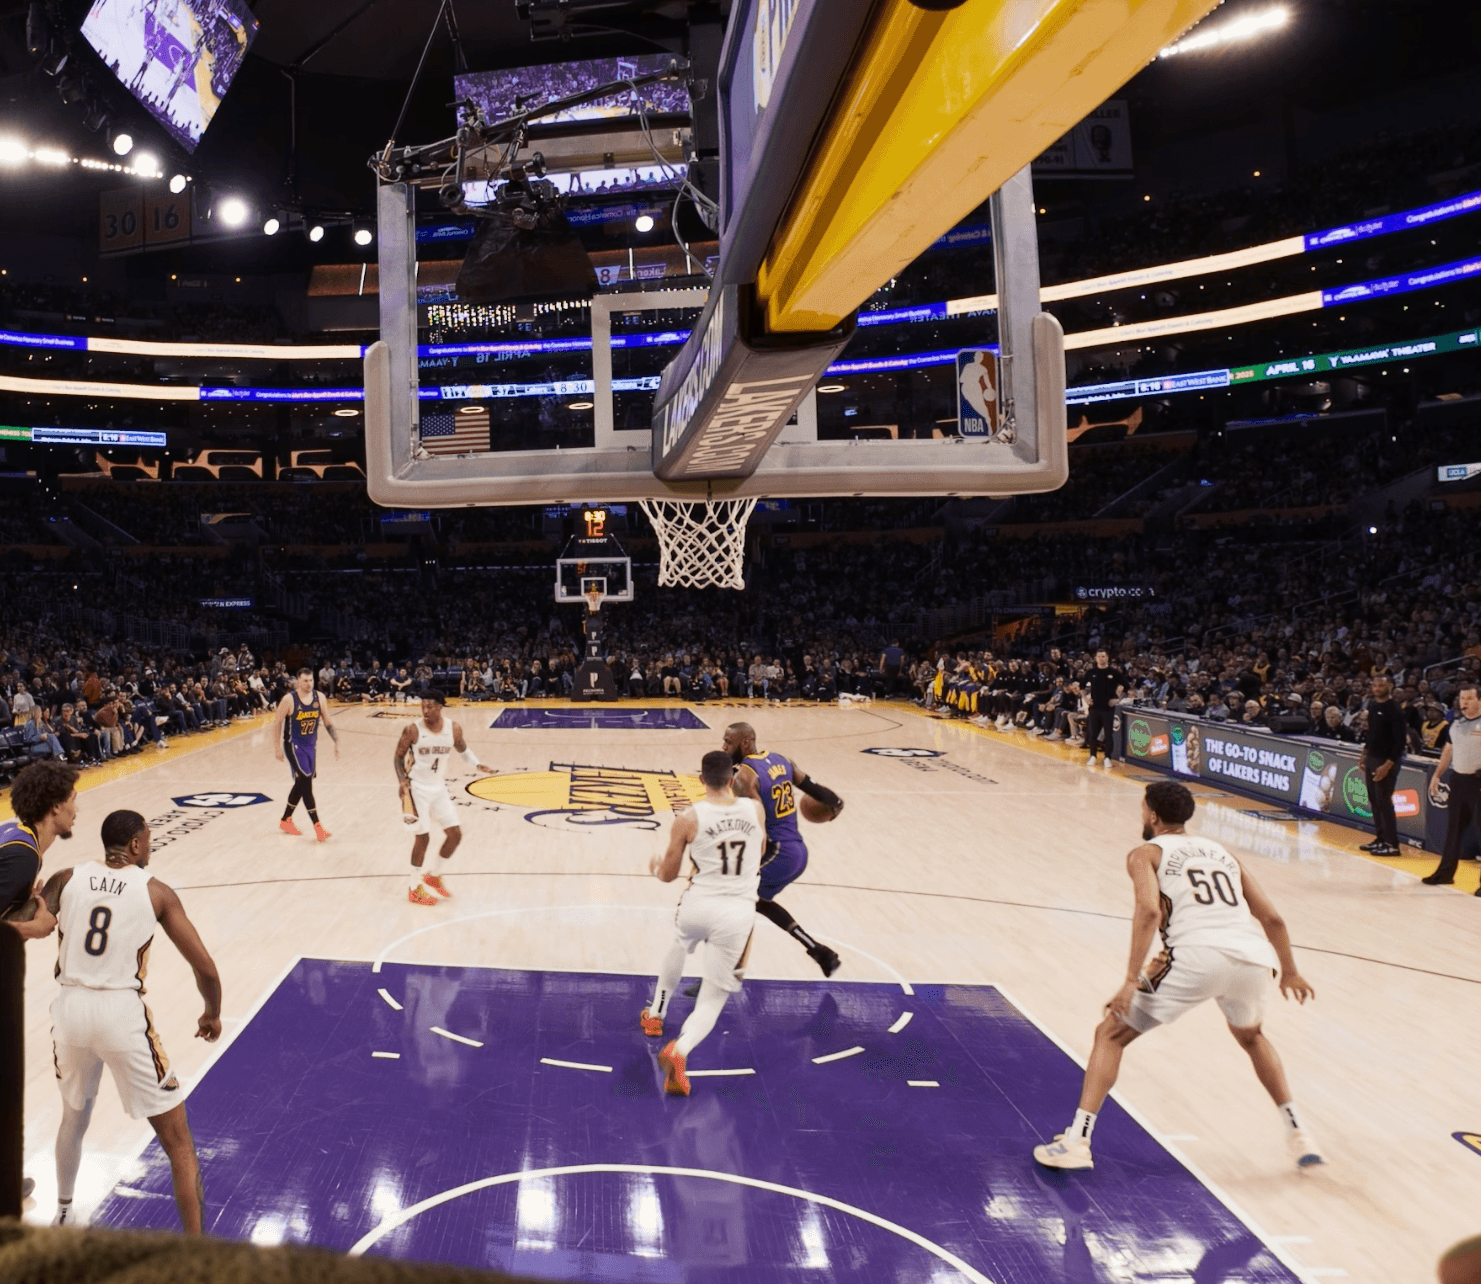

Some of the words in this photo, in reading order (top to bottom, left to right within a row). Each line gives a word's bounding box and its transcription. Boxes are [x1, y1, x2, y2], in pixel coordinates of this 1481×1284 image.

[106, 211, 137, 238] 30
[1267, 363, 1299, 375] APRIL
[1392, 343, 1435, 356] THEATER
[684, 373, 815, 474] LAKERS.COM
[964, 418, 984, 434] NBA
[588, 521, 604, 537] 12
[301, 720, 316, 736] 77
[431, 758, 439, 774] 4
[1205, 738, 1224, 753] THE
[1225, 744, 1258, 764] GO-TO
[1258, 750, 1296, 773] SNACK
[1208, 757, 1222, 773] OF
[1223, 761, 1260, 784] LAKERS
[1260, 772, 1290, 792] FANS
[771, 780, 796, 818] 23
[705, 819, 756, 839] MATKOVIC
[717, 841, 746, 876] 17
[90, 876, 127, 896] CAIN
[1187, 868, 1239, 907] 50
[85, 907, 111, 957] 8
